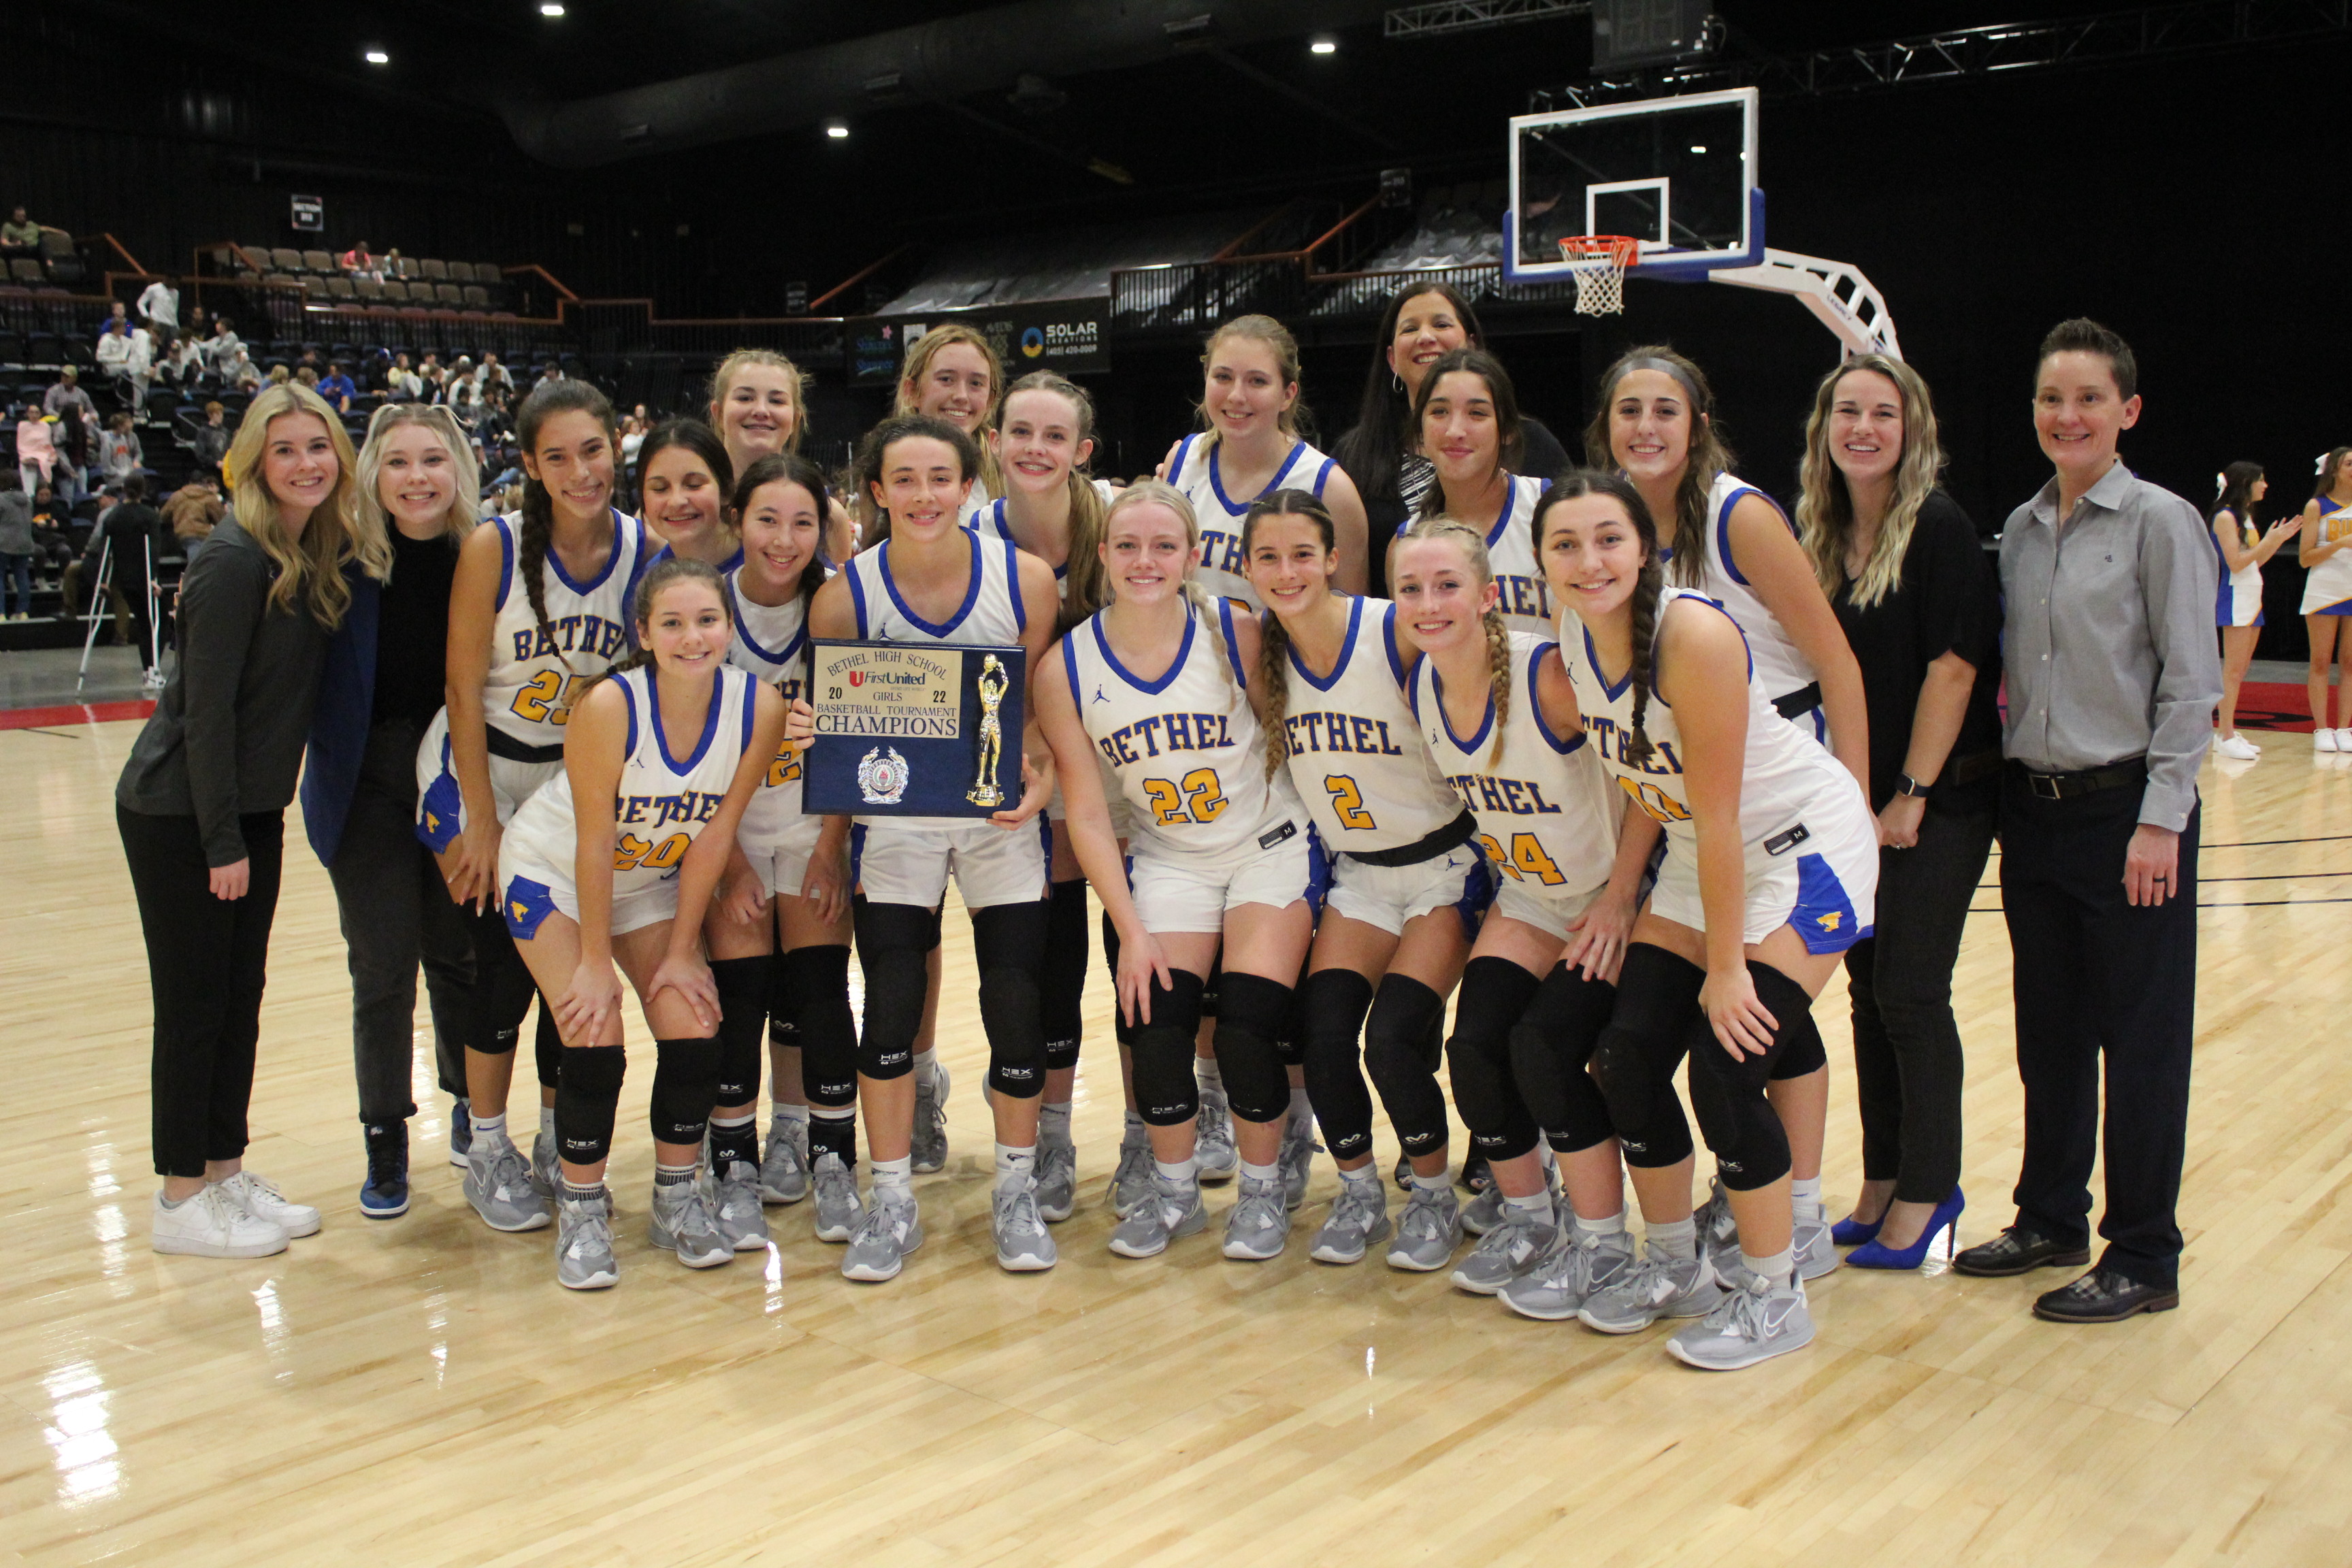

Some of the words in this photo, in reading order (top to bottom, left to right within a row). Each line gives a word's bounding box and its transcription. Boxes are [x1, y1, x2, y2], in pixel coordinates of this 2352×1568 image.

[1046, 321, 1098, 338] SOLAR
[513, 615, 623, 661] BETHE
[827, 653, 869, 676] BETHEL
[874, 651, 902, 663] HIGH
[906, 654, 947, 680] SCHOOL
[829, 687, 842, 700] 20
[873, 691, 902, 702] GIRLS
[933, 690, 946, 703] 22
[817, 704, 881, 715] BASKETBALL
[887, 706, 957, 717] TOURNAMENT
[816, 715, 957, 736] CHAMPIONS
[1099, 713, 1237, 768] BETHEL
[1282, 711, 1403, 760] ETHEL
[1142, 767, 1230, 826] 22
[1324, 774, 1377, 830] 2
[1284, 826, 1292, 835] M
[1793, 830, 1803, 839] M
[613, 832, 693, 871] 20
[881, 1050, 907, 1060] HEX
[1002, 1066, 1031, 1075] HEX
[821, 1082, 851, 1090] HEX
[567, 1138, 597, 1146] HEX
